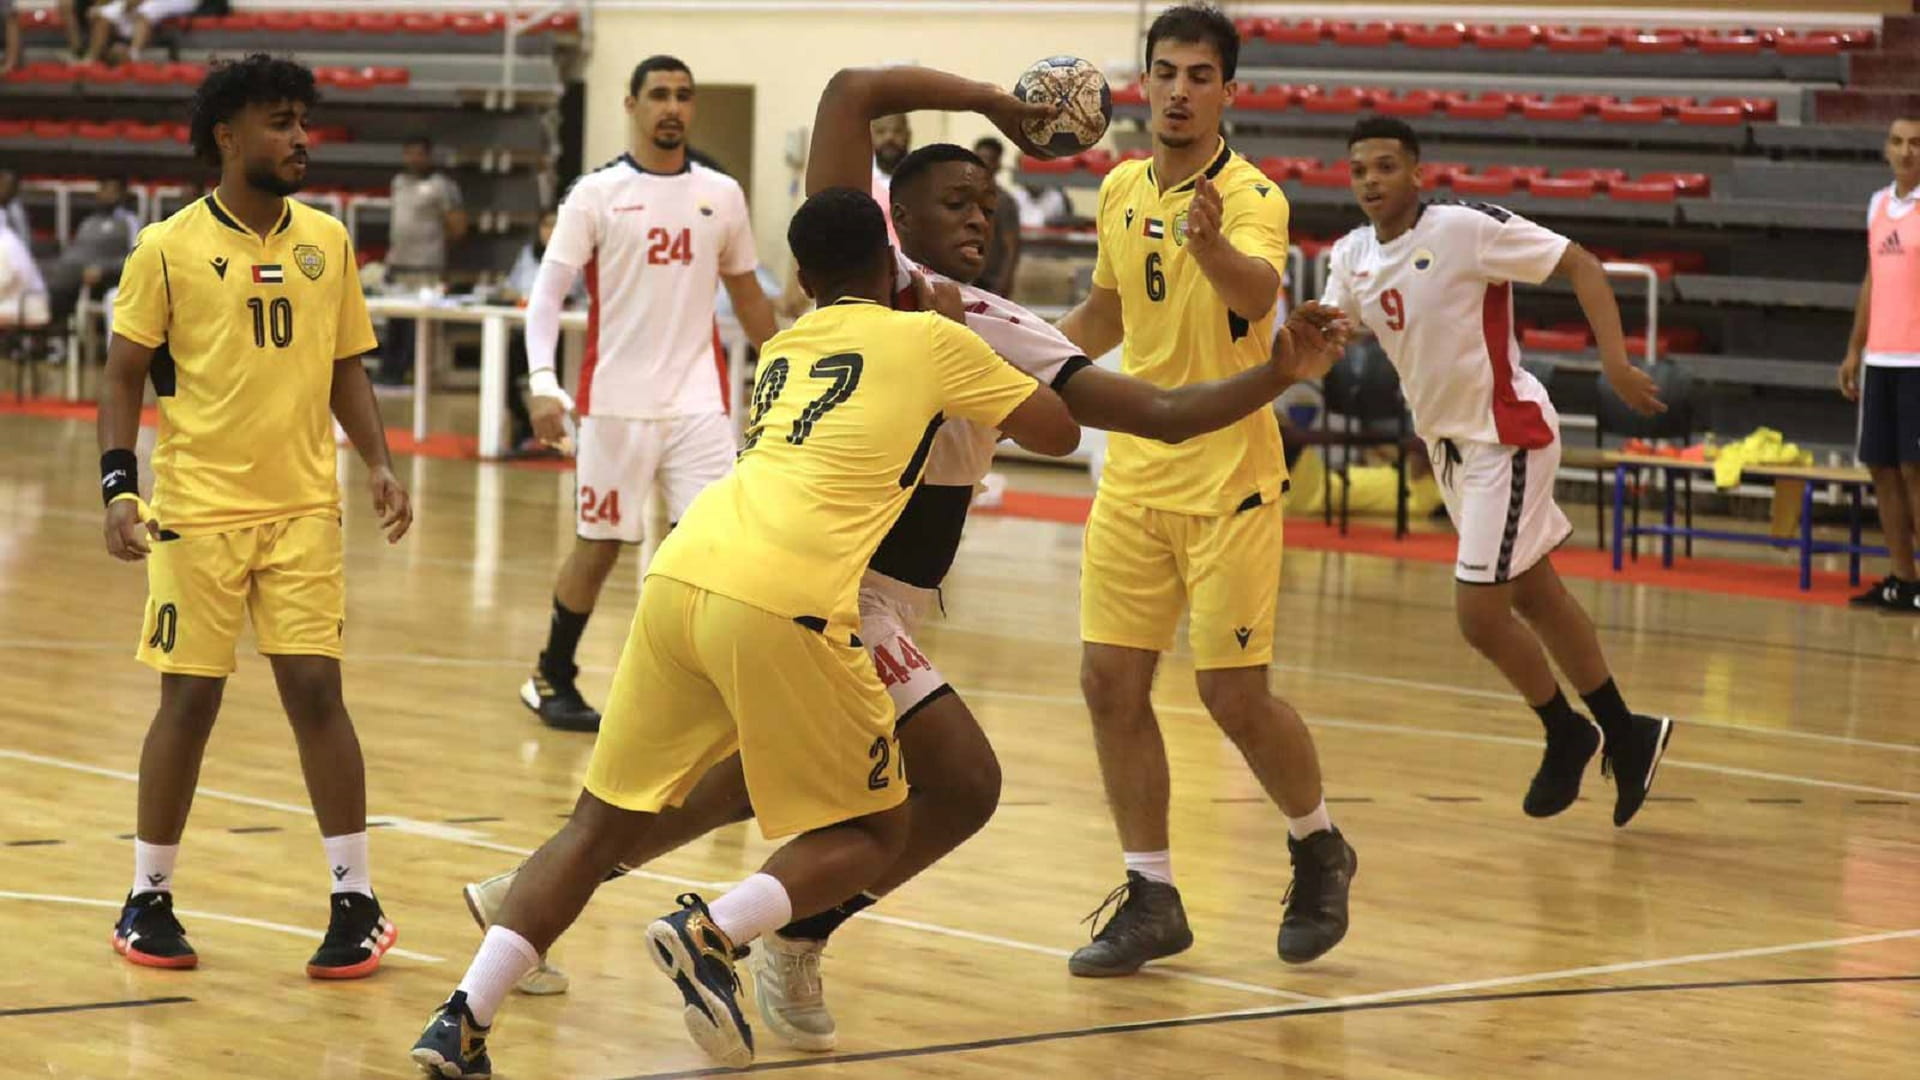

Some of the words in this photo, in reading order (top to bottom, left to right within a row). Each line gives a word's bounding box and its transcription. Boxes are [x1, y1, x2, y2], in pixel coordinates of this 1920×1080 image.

[647, 227, 693, 266] 24
[1146, 252, 1165, 301] 6
[247, 297, 293, 348] 10
[1380, 288, 1405, 331] 9
[580, 486, 621, 527] 24
[868, 736, 902, 791] 2
